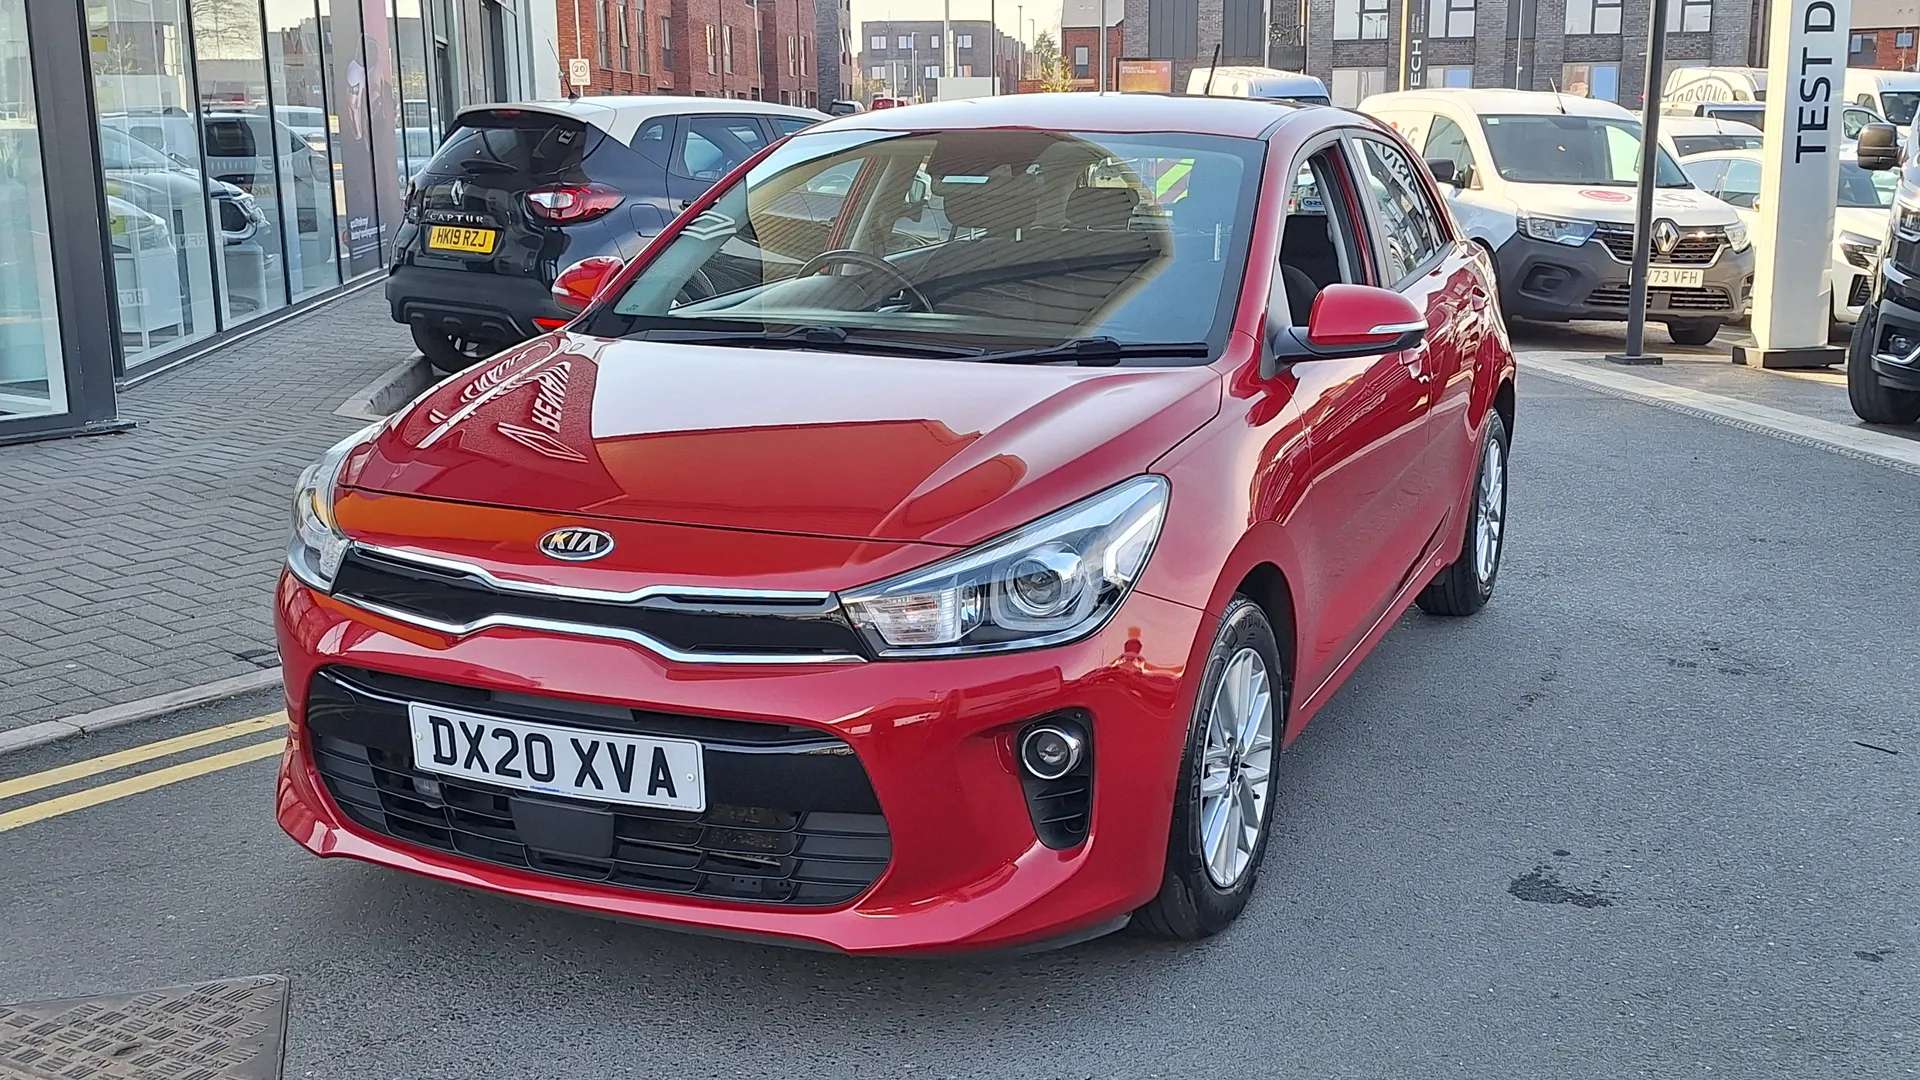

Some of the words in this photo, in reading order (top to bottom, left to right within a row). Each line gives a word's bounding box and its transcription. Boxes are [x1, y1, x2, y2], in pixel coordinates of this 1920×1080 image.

[1804, 1, 1835, 34] D
[1410, 39, 1422, 91] ECH
[1795, 46, 1832, 163] TEST
[430, 213, 484, 223] CAPTUR
[436, 227, 462, 245] HK19
[463, 230, 488, 248] RZJ
[1674, 271, 1698, 284] VFH
[548, 531, 599, 553] KIA
[428, 715, 556, 783] DX20
[570, 738, 678, 798] XVA
